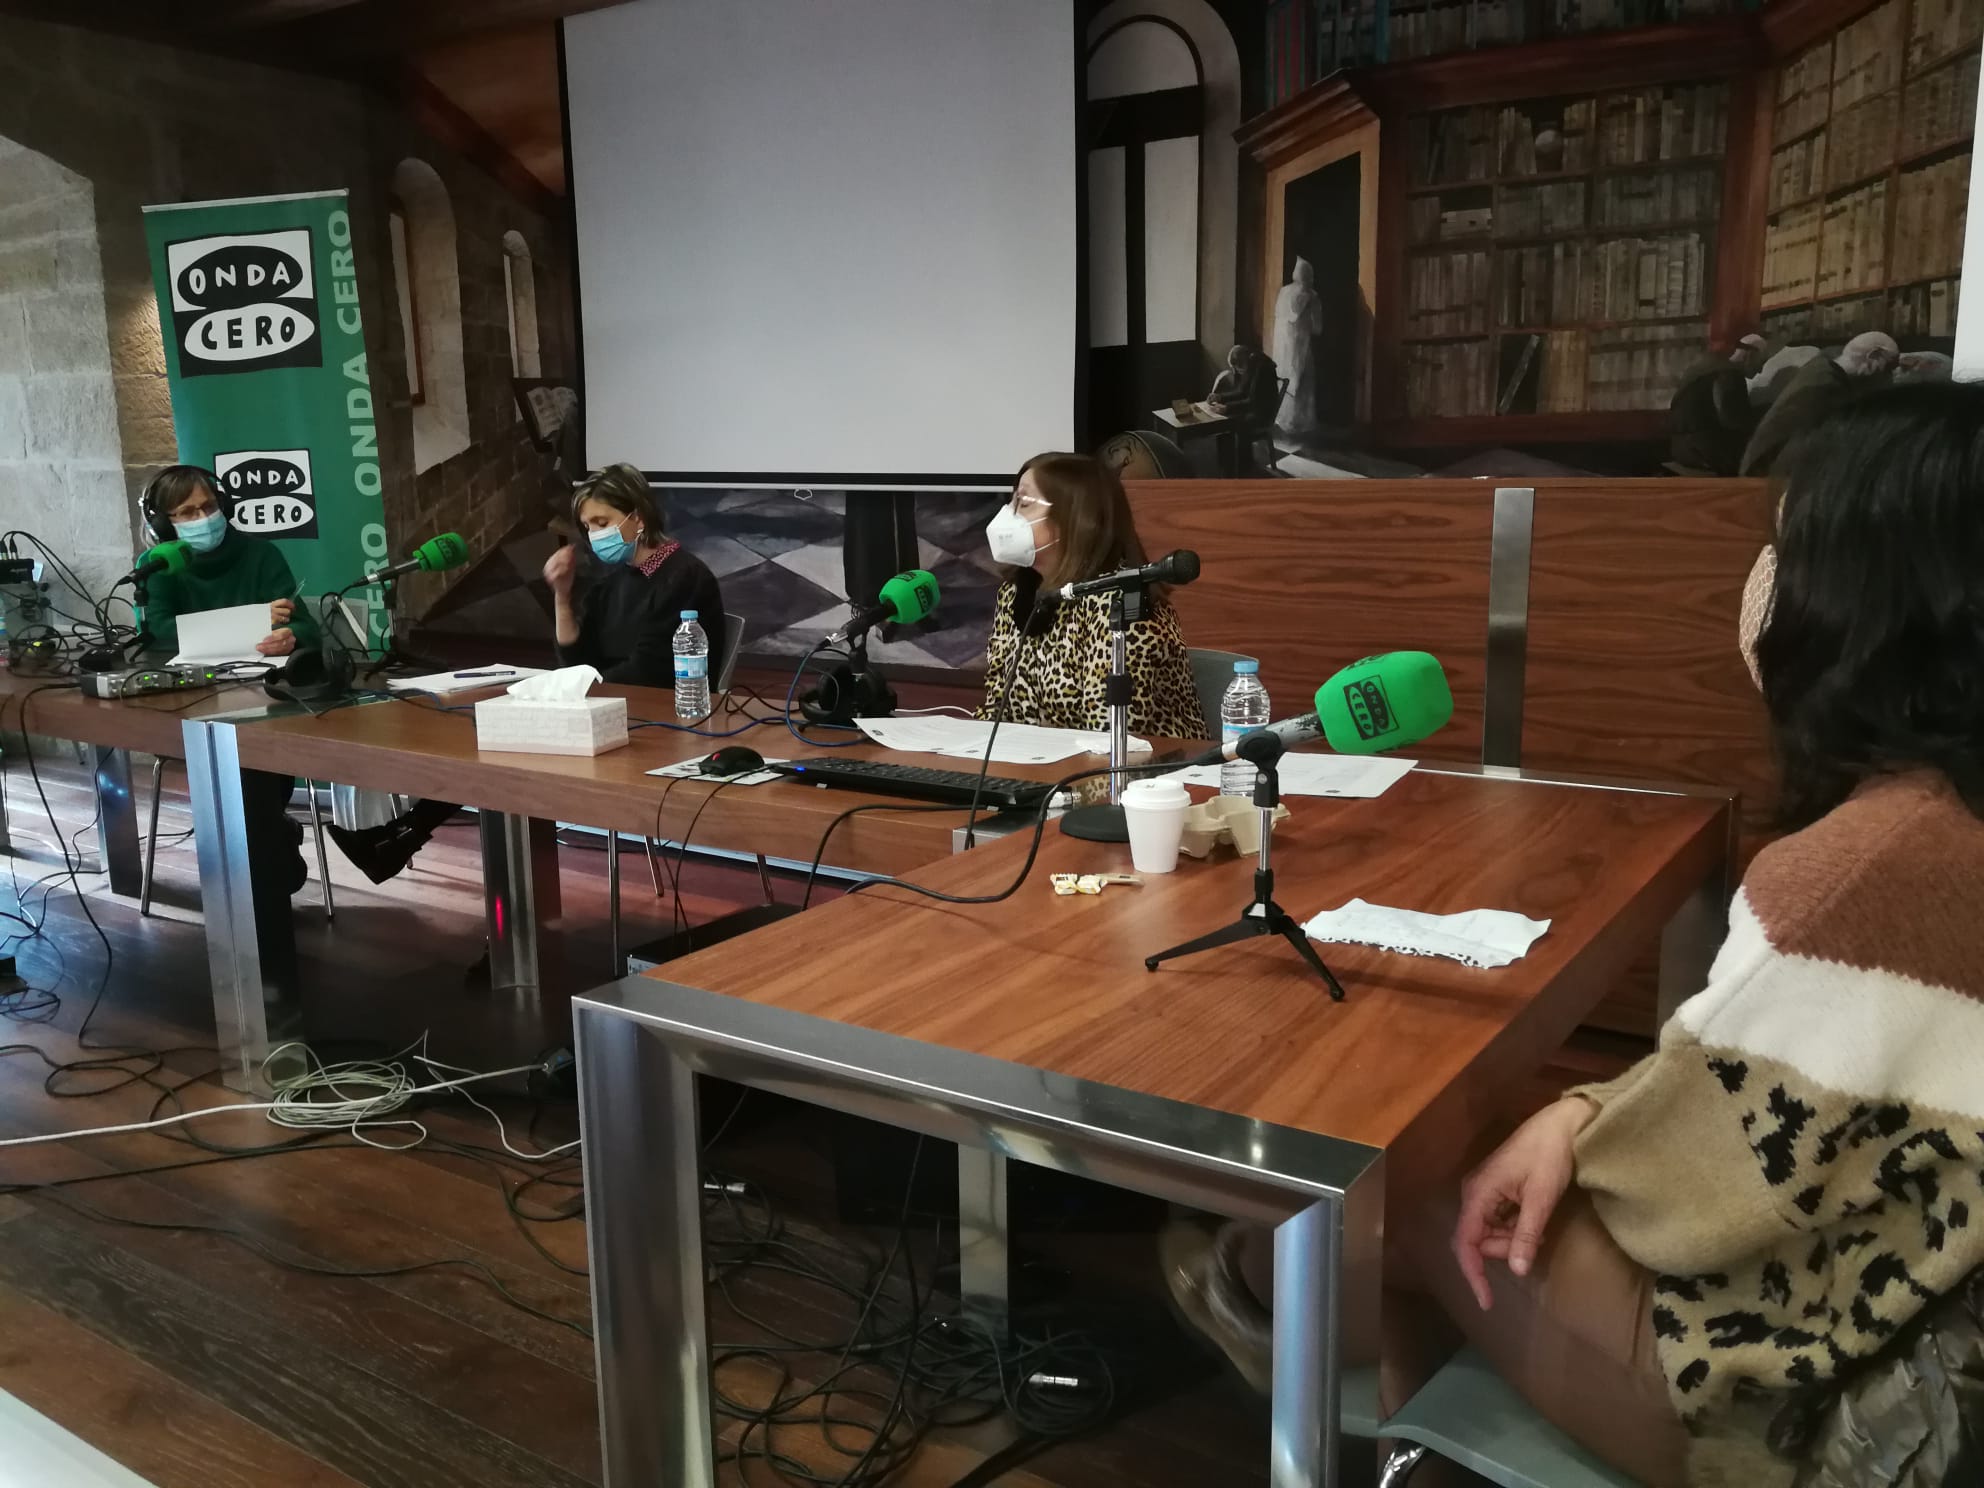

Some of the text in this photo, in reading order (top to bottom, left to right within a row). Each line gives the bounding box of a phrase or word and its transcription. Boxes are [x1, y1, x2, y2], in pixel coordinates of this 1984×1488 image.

[188, 261, 290, 295] ONDA
[328, 210, 363, 335] CERO
[201, 315, 296, 350] CERO
[343, 352, 382, 497] ONDA
[229, 469, 299, 489] ONDA
[237, 504, 302, 525] CERO
